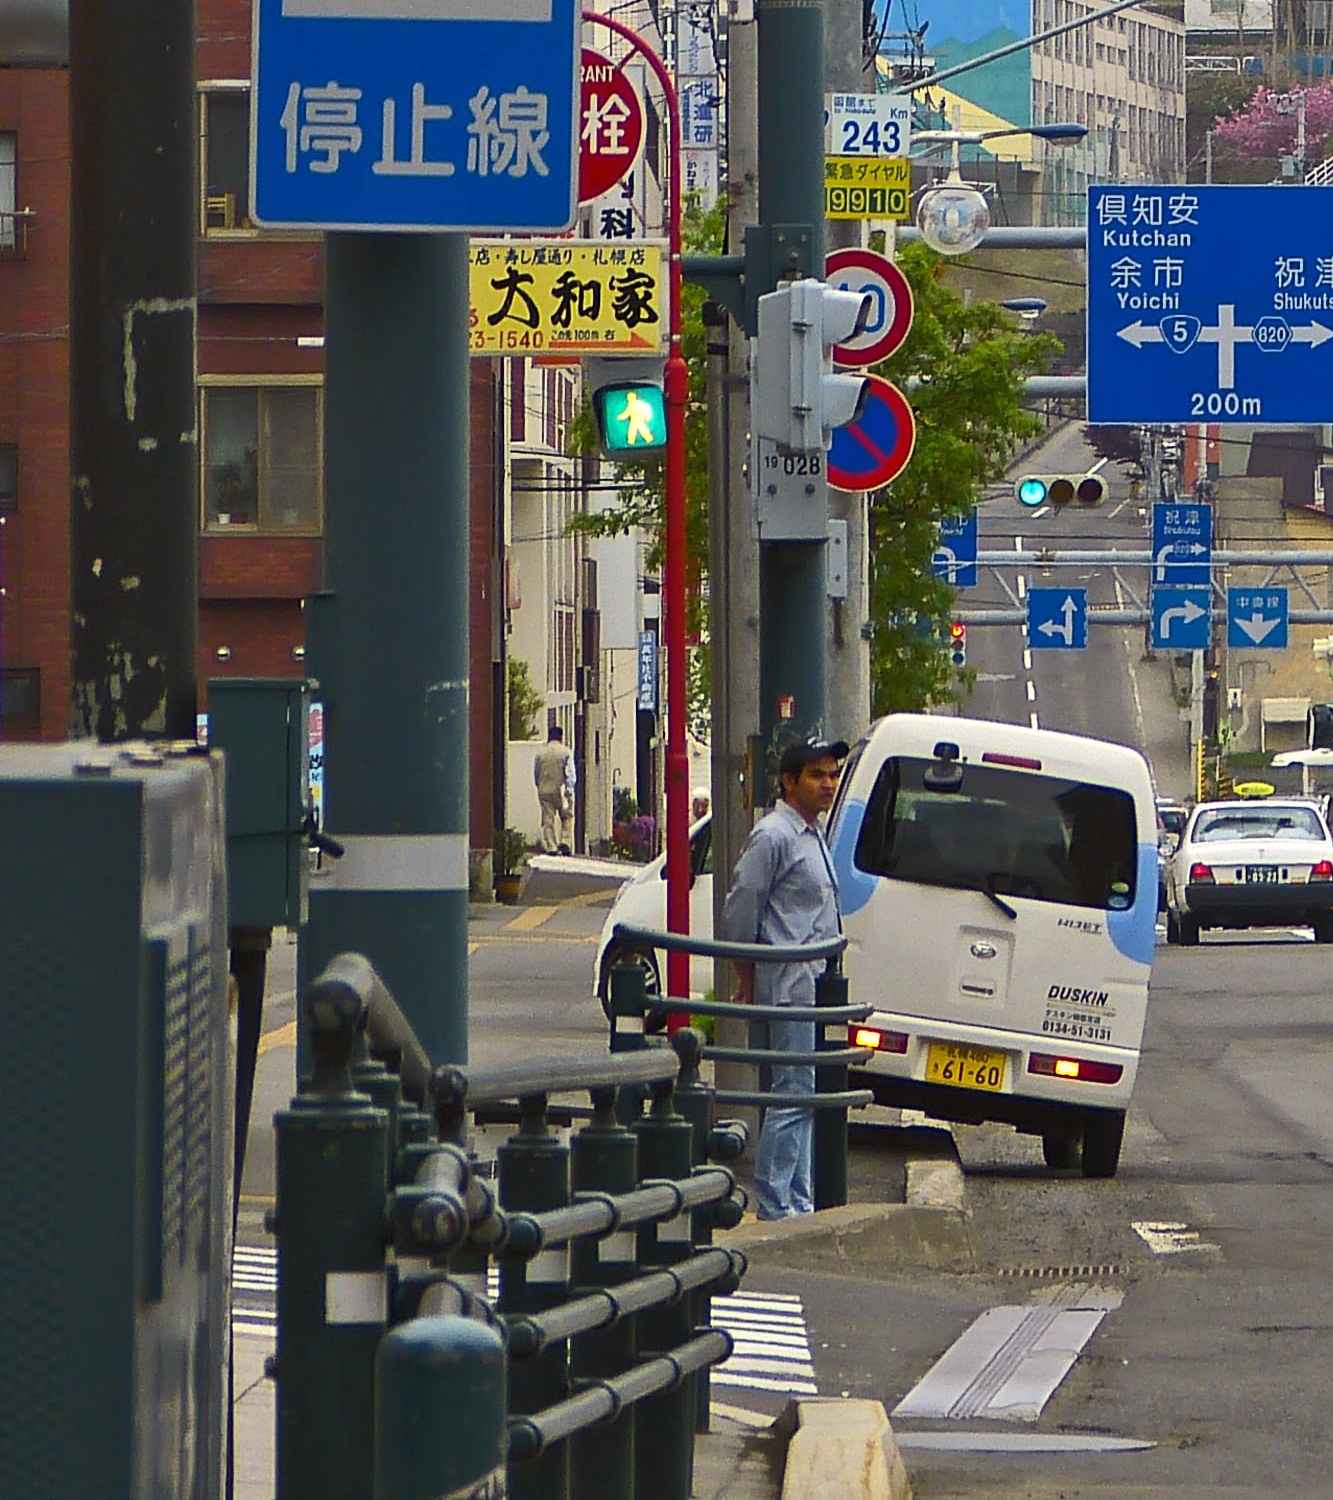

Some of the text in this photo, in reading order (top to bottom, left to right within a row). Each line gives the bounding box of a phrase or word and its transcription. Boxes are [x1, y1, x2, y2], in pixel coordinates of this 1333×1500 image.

[579, 65, 615, 82] RANT
[579, 93, 632, 155] 栓
[890, 107, 908, 119] Km
[279, 79, 551, 177] 停止線
[842, 120, 901, 154] 243
[831, 188, 905, 213] 9910
[1096, 193, 1199, 226] 倶知安
[1104, 230, 1191, 247] Kutchan
[469, 248, 646, 266] 店・寿し屋通り・札幌店
[1110, 256, 1184, 288] 余市
[487, 266, 659, 329] 大和家
[1117, 292, 1179, 310] Yoichi
[469, 330, 544, 349] 3-1540
[1173, 320, 1286, 343] 5 820
[1191, 393, 1261, 416] 200m
[784, 456, 821, 476] 028
[1236, 595, 1280, 608] 中央線
[1047, 985, 1109, 1007] DUSKIN
[942, 1060, 1000, 1087] 61-60
